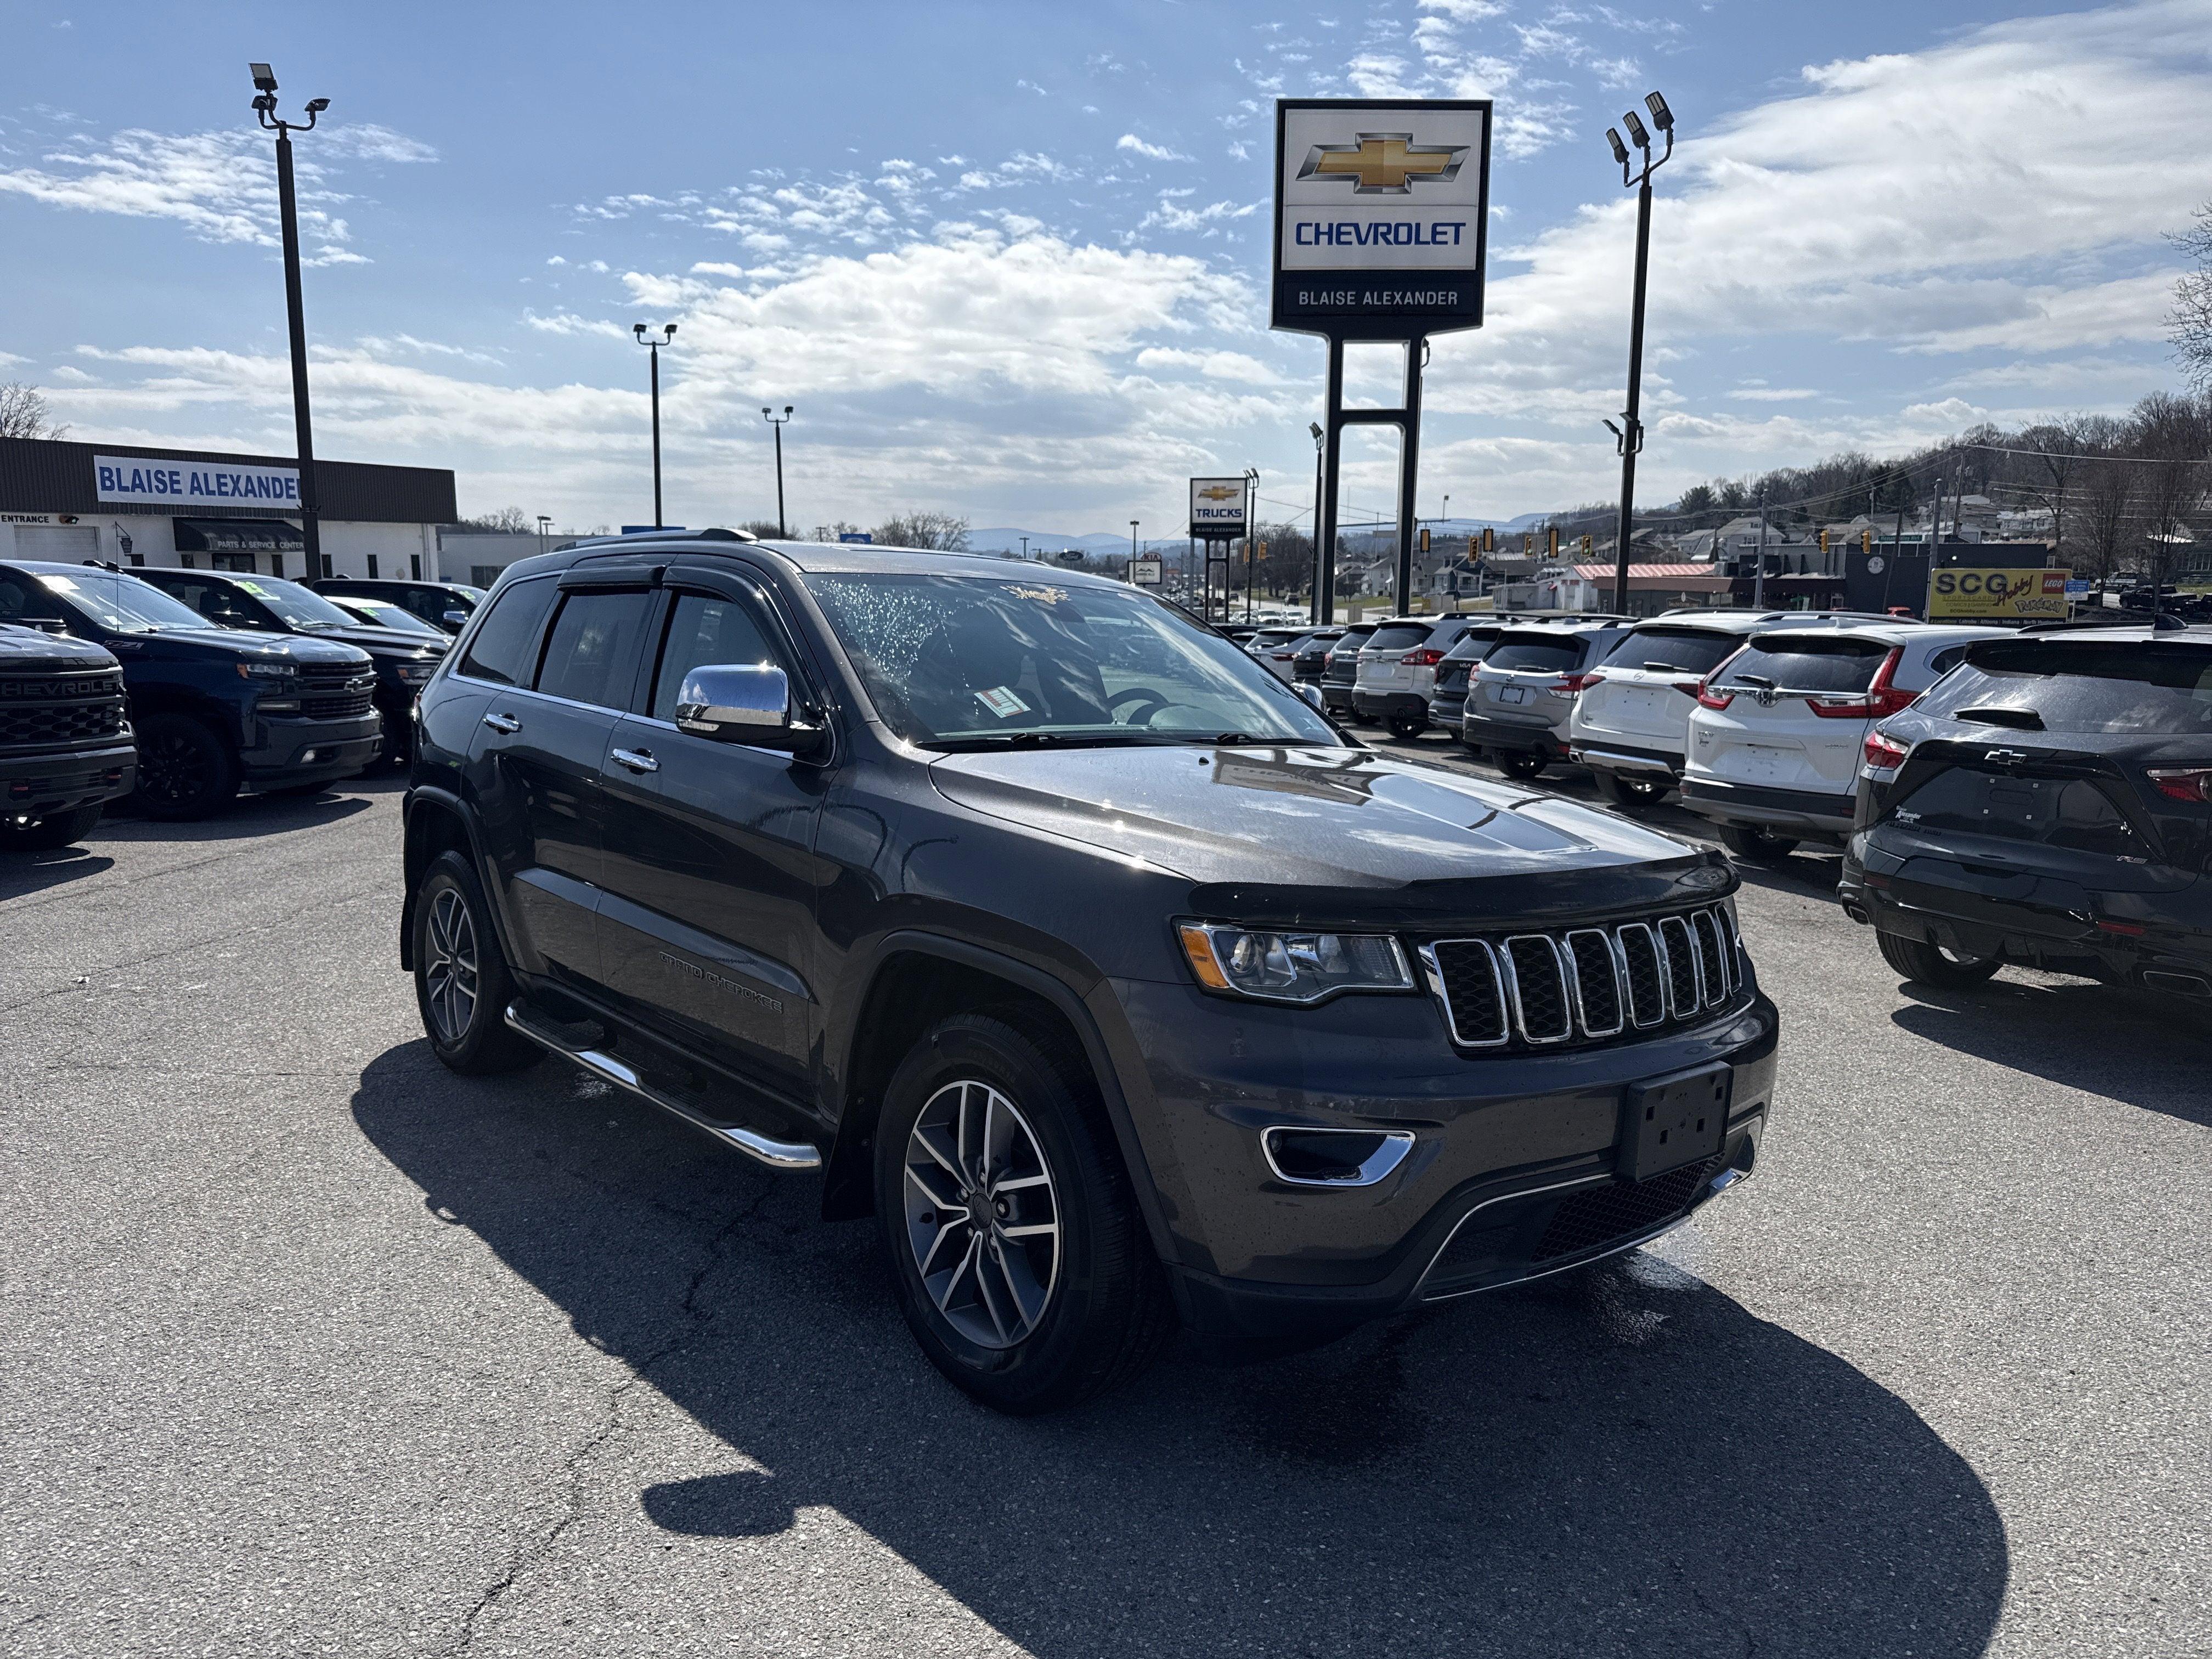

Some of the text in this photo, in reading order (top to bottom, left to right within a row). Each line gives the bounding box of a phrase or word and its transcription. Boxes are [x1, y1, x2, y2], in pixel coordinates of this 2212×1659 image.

[1296, 222, 1466, 246] CHEVROLET
[1299, 291, 1458, 306] BLAISE ALEXANDER
[99, 466, 302, 500] BLAISE ALEXANDE
[1, 515, 50, 523] ENTRANCE
[1195, 509, 1242, 518] TRUCKS
[1935, 573, 2034, 606] SCG Hobby
[2044, 579, 2063, 588] LEGO
[0, 678, 121, 696] HEVROLET
[659, 951, 784, 1014] GRAND CHEROKEE
